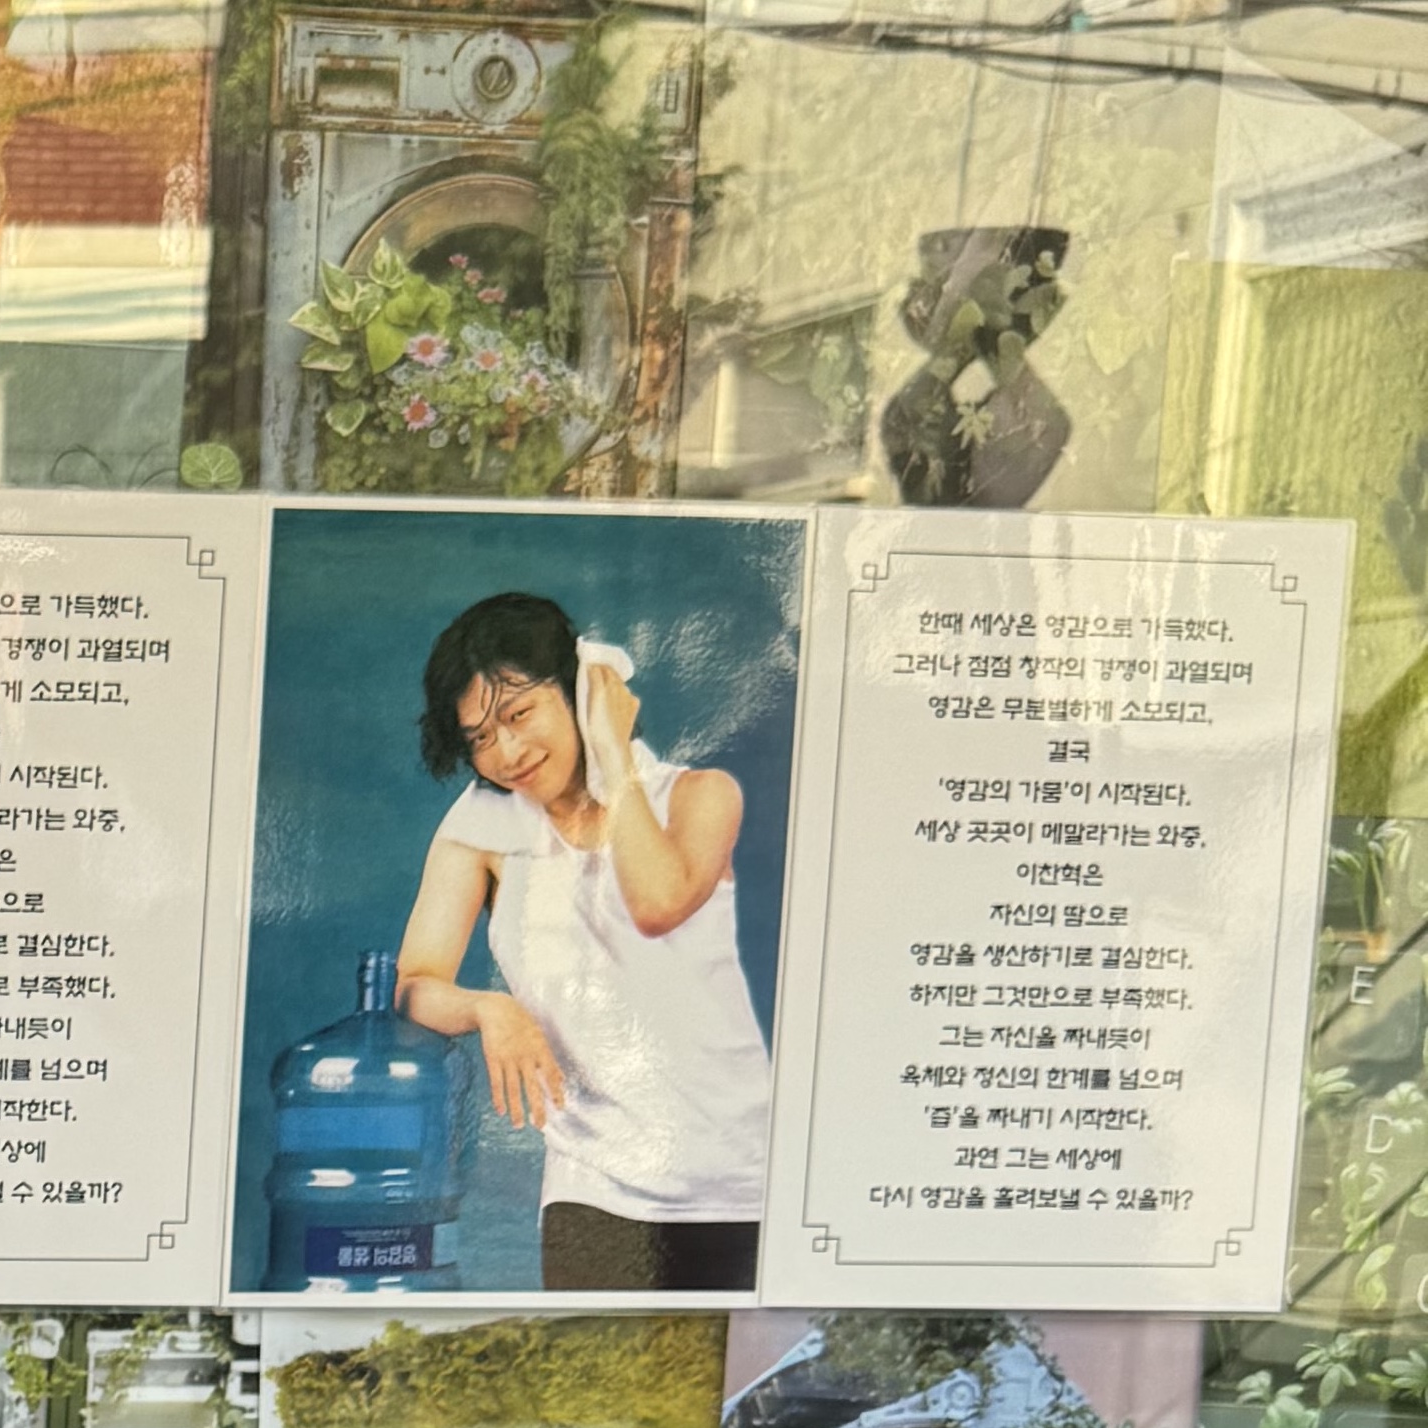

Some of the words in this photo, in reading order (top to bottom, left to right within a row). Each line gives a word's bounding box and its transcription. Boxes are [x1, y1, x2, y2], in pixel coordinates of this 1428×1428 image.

[918, 609, 965, 636] 한때
[969, 611, 1038, 638] 세상은
[1044, 614, 1134, 640] 영감으로
[0, 636, 71, 663] 경쟁이
[75, 636, 172, 665] 과열되며
[891, 652, 963, 679] 그러나
[967, 654, 1013, 680] 점점
[1018, 654, 1087, 681] 창작의
[1092, 657, 1159, 683] 경쟁이
[1164, 659, 1254, 686] 과열되며
[927, 694, 996, 721] 영감은
[1046, 739, 1092, 765] 결국
[913, 818, 963, 844] 세상
[966, 819, 1036, 845] 곳곳이
[1040, 821, 1152, 848] 메말라가는
[1015, 861, 1105, 888] 이찬혁은
[988, 902, 1058, 929] 자신의
[1062, 903, 1129, 929] 땀으로
[908, 941, 978, 968] 영감을
[982, 943, 1094, 969] 생산하기로
[908, 982, 979, 1009] 하지만
[981, 984, 1094, 1010] 그것만으로
[938, 1024, 985, 1049] 그는
[989, 1024, 1058, 1051] 자신을
[1061, 1026, 1152, 1052] 짜내듯이
[39, 1056, 109, 1083] 넘으며
[972, 1065, 1041, 1090] 정신의
[1045, 1065, 1113, 1091] 한계를
[1118, 1067, 1185, 1092] 넘으며
[985, 1105, 1054, 1131] 짜내기
[953, 1145, 1000, 1171] 과연
[1003, 1146, 1051, 1171] 그는
[1054, 1147, 1124, 1172] 세상에
[10, 1179, 35, 1205] 수
[41, 1179, 124, 1205] 있을까?
[868, 1185, 915, 1210] 다시
[919, 1185, 988, 1210] 영감을
[1085, 1186, 1110, 1212] 수
[1114, 1186, 1195, 1212] 있을까?
